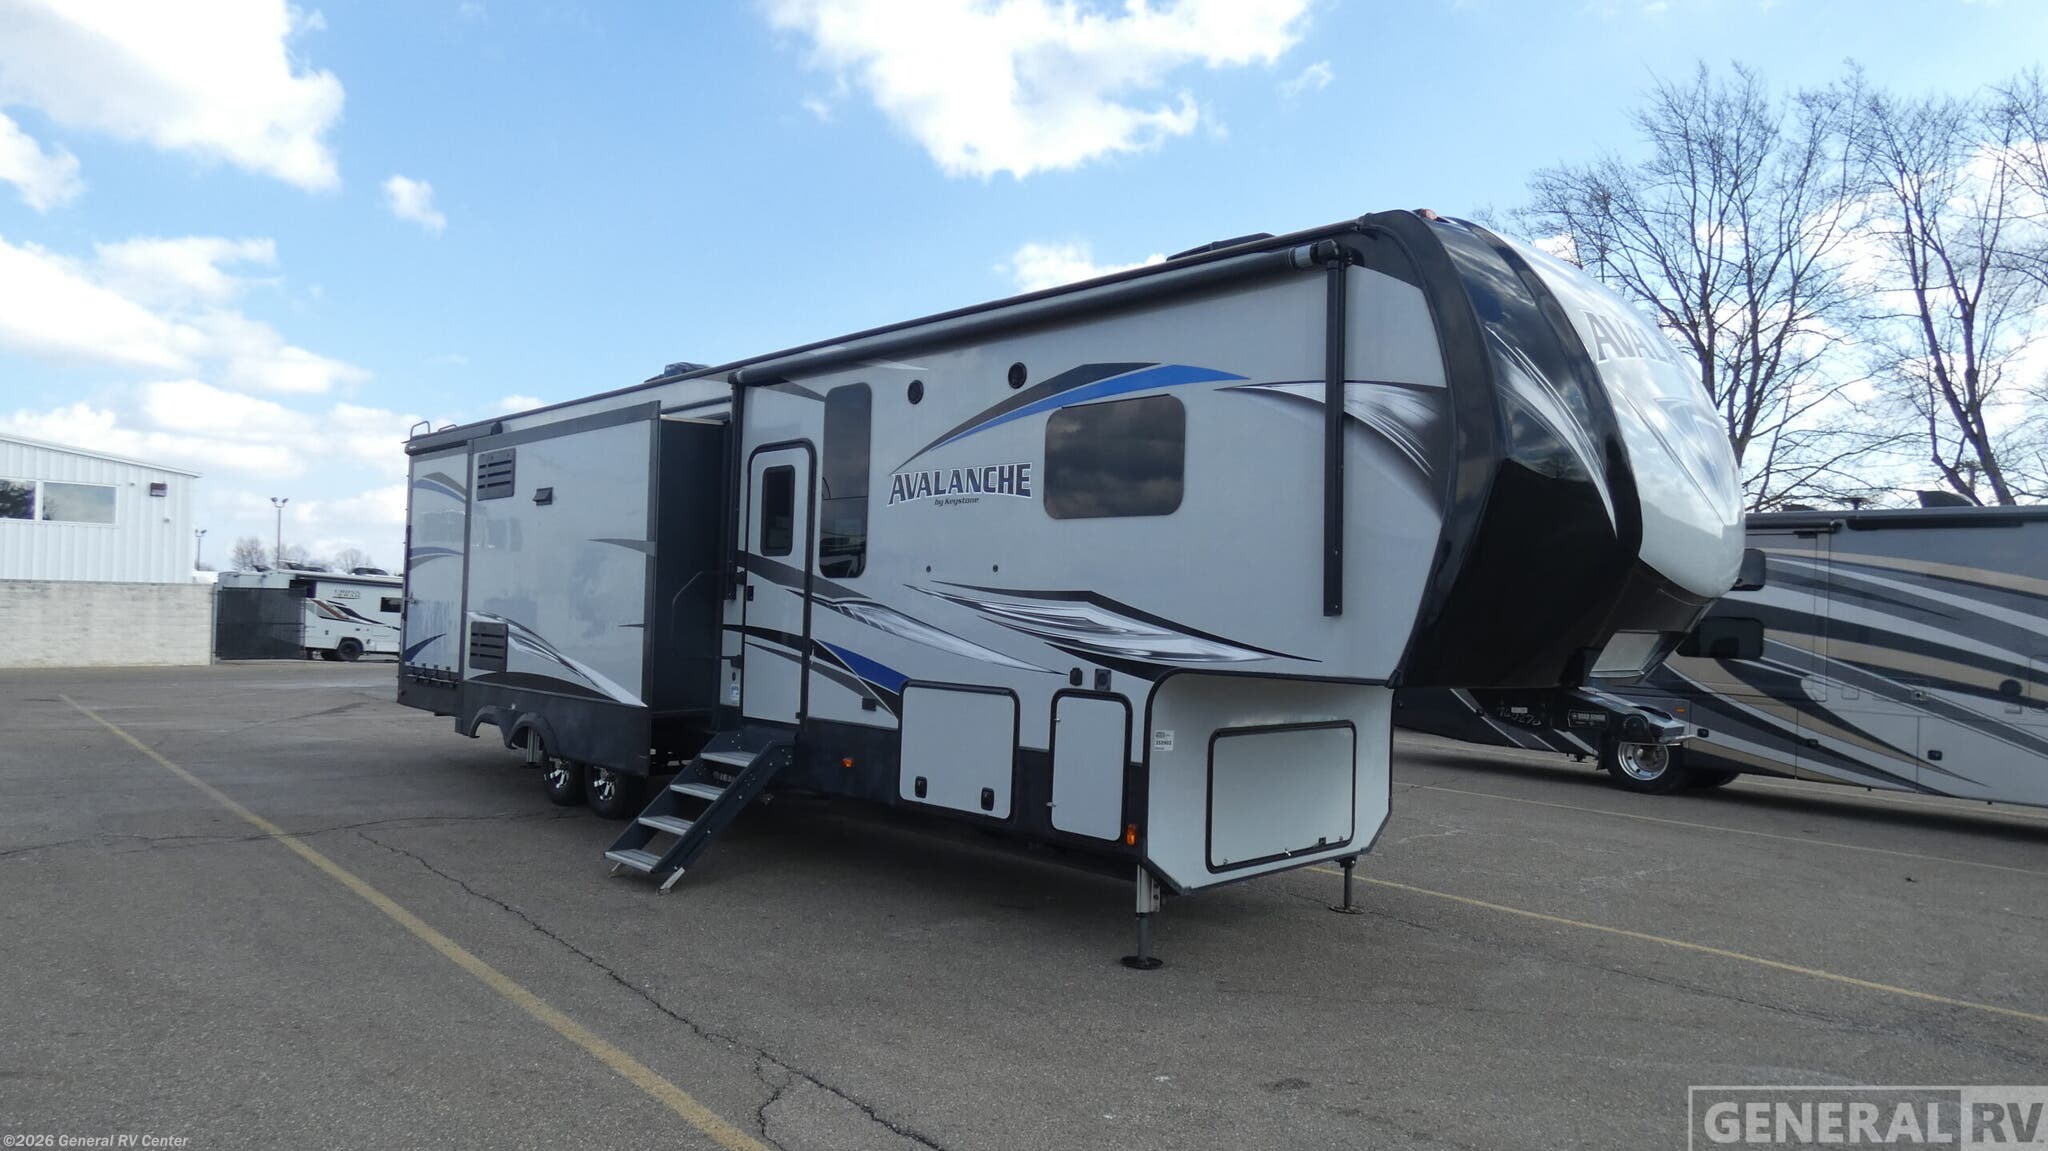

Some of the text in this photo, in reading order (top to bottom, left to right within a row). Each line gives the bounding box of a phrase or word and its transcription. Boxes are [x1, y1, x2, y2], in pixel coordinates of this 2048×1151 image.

[887, 462, 1032, 507] AVALANCHE
[934, 497, 980, 507] by Keystone
